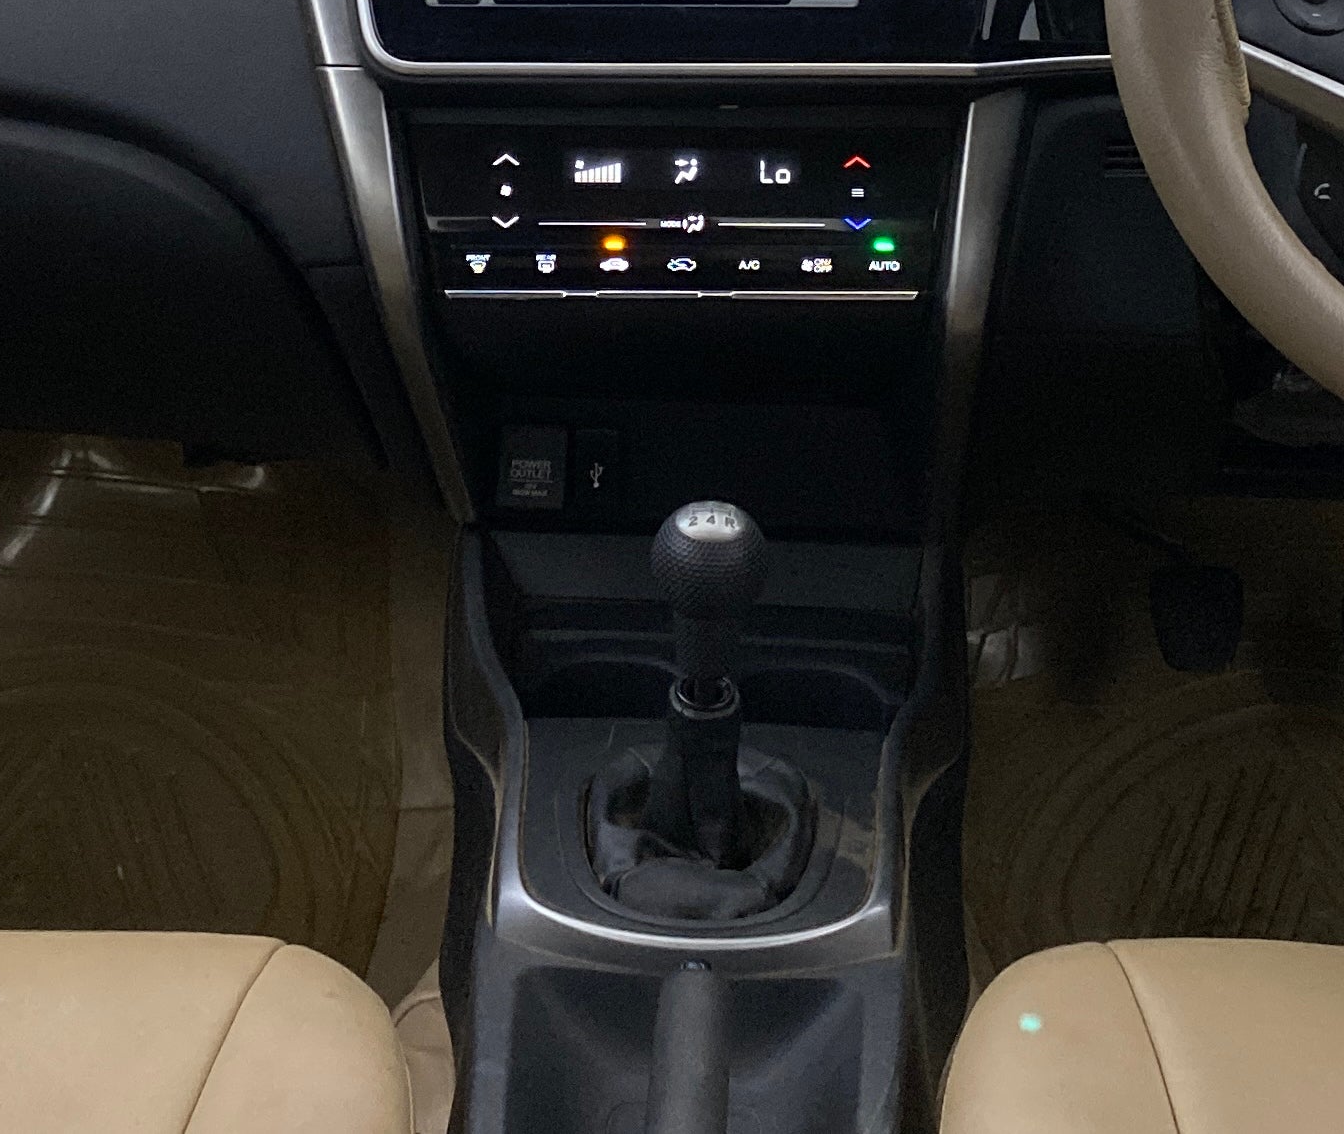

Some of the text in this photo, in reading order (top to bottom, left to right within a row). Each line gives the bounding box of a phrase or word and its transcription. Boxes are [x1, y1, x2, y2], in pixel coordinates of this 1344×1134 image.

[759, 159, 791, 185] Lo
[738, 259, 761, 272] A/C
[868, 260, 901, 273] AUTO
[687, 514, 736, 529] 2 4 R
